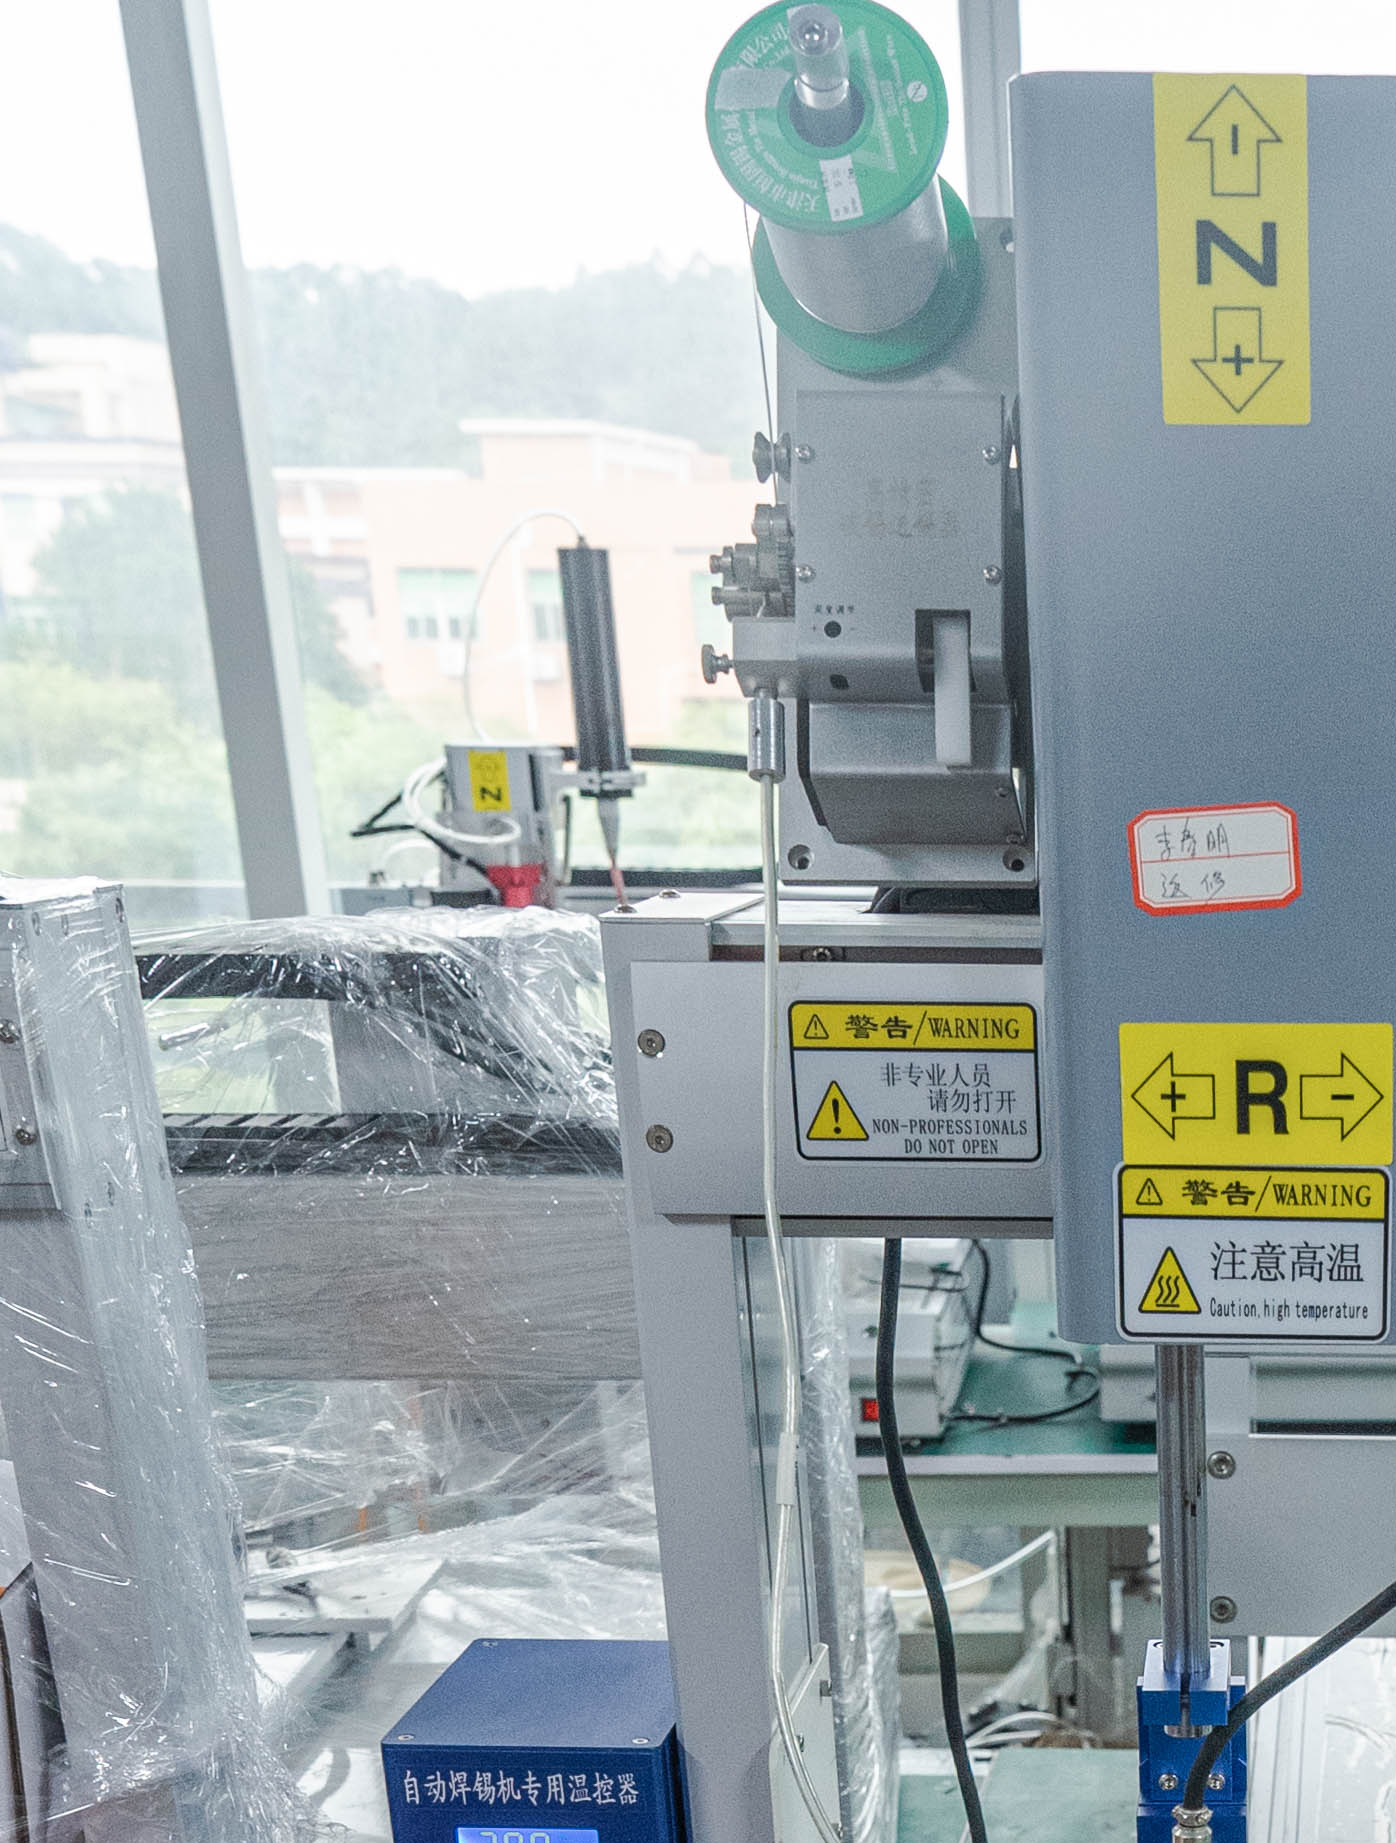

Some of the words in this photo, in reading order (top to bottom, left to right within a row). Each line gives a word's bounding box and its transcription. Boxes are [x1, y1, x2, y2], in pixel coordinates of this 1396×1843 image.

[845, 1010, 1020, 1045] 警告/WARNING
[880, 1062, 991, 1088] 非专业人员
[927, 1089, 1017, 1114] 请勿打开
[1235, 1059, 1289, 1135] R
[872, 1118, 1028, 1136] NON-PROFESSIONALS
[904, 1138, 923, 1154] DO
[929, 1138, 955, 1154] NOT
[962, 1139, 999, 1155] OPEN
[1181, 1176, 1372, 1213] 警告/WARNING
[1210, 1240, 1364, 1283] 注意高温
[1295, 1302, 1369, 1321] temperature
[403, 1770, 640, 1806] 自动焊锡机专用温控器
